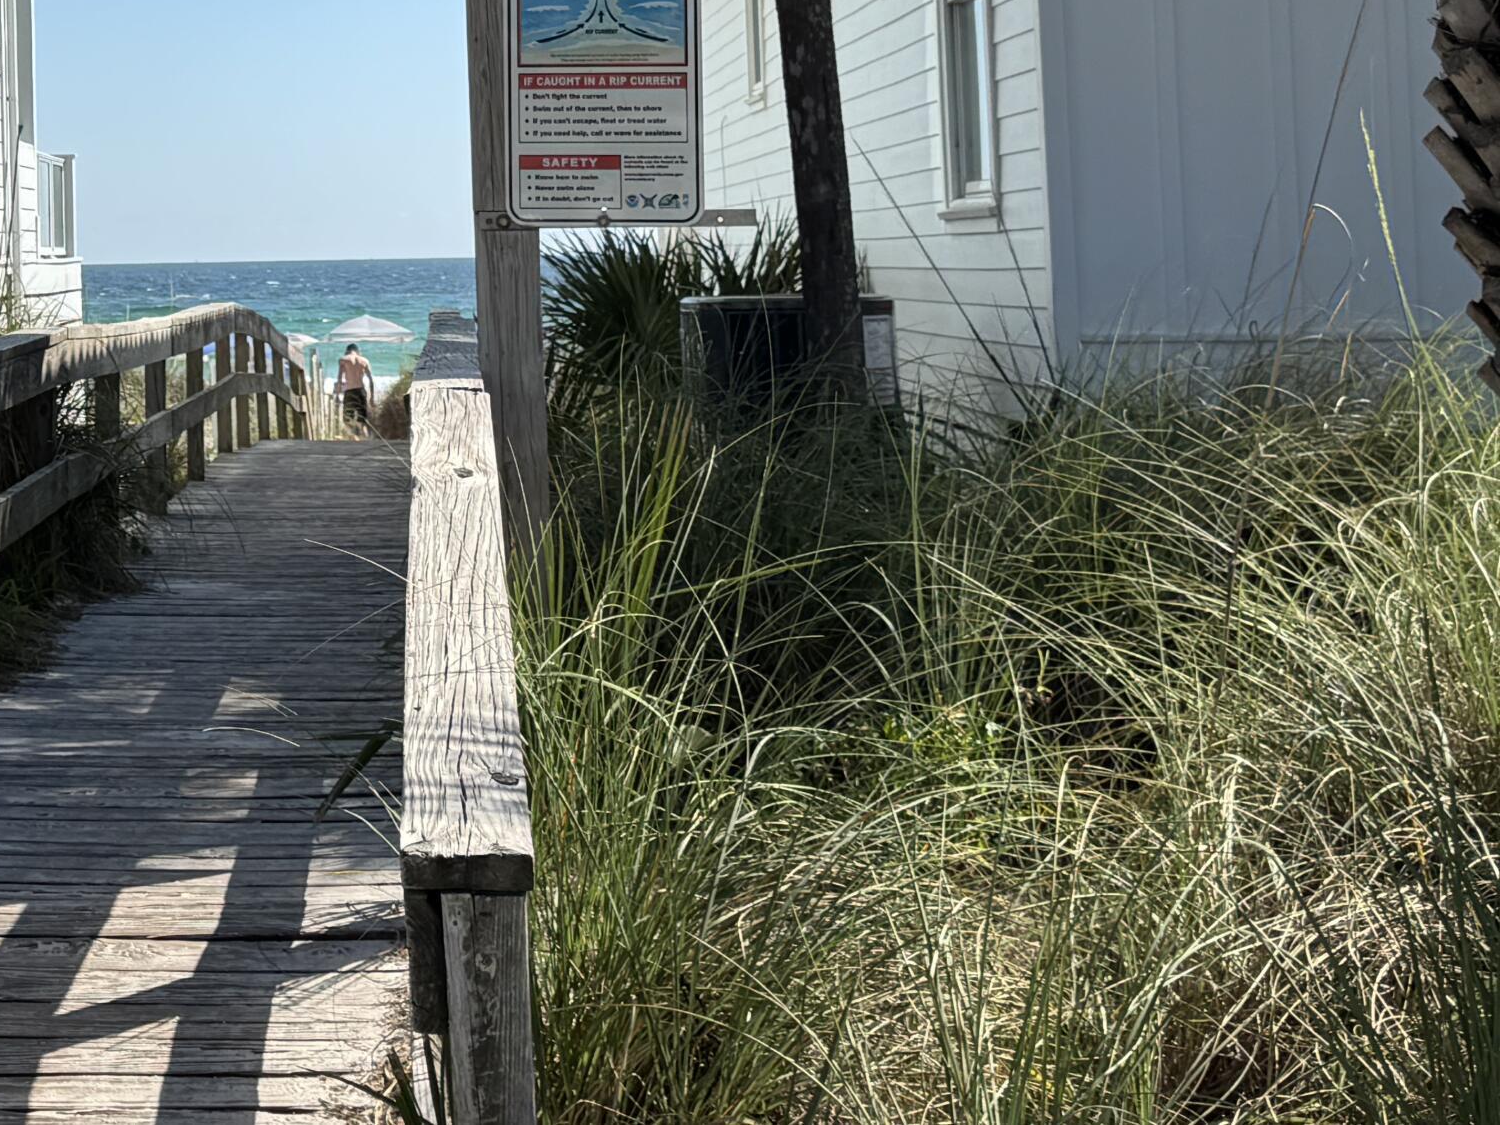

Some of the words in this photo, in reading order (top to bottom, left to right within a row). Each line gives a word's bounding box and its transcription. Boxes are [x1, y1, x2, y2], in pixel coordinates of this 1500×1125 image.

[524, 77, 533, 86] IF
[536, 77, 580, 86] CAUGHT
[584, 76, 595, 86] IN
[598, 76, 606, 86] A
[609, 76, 627, 86] RIP
[630, 75, 681, 86] CURRENT
[542, 158, 598, 168] SAFETY
